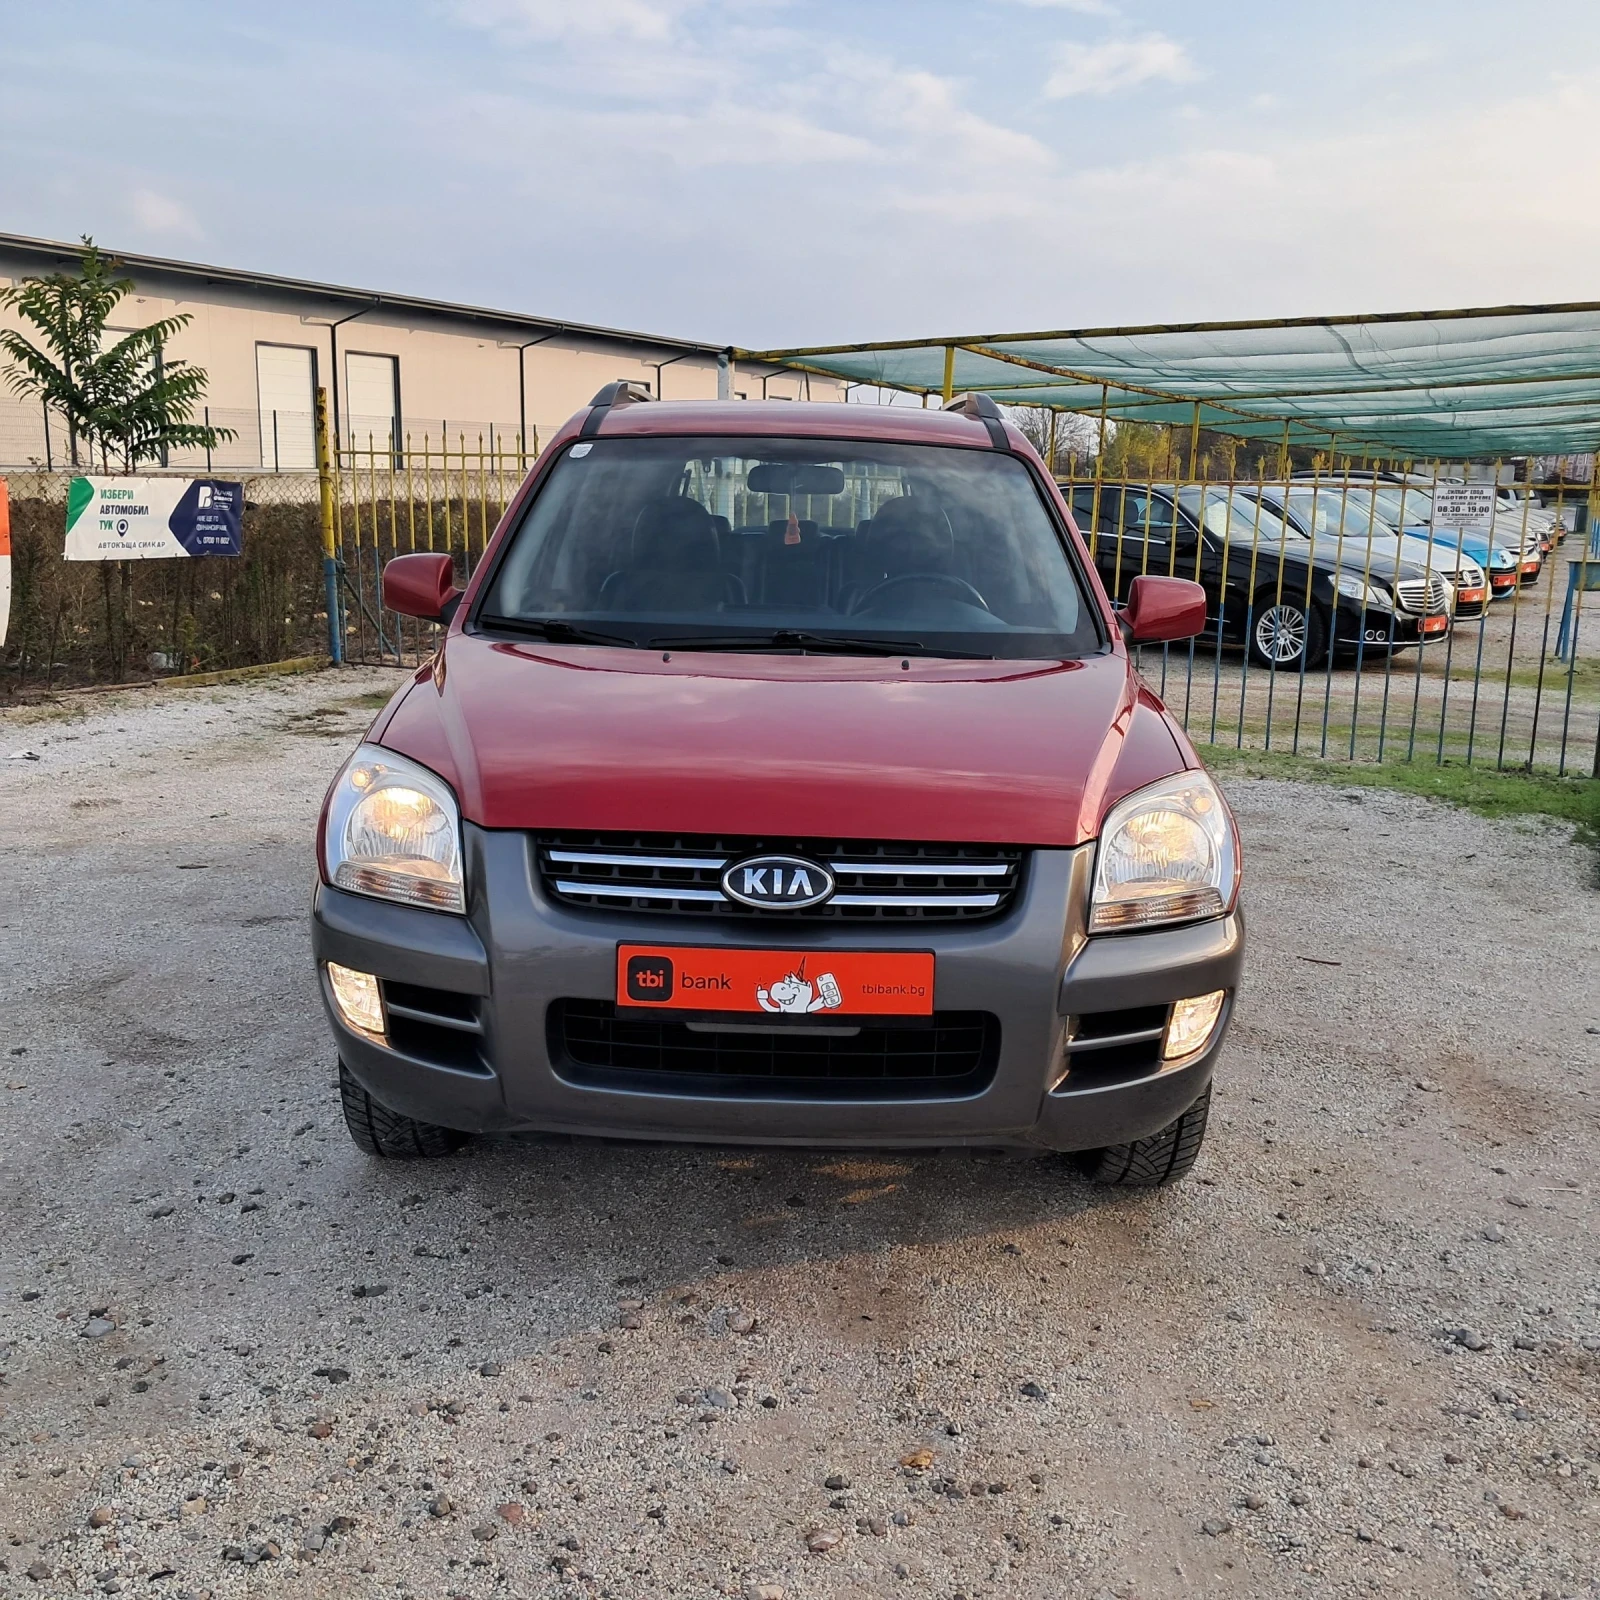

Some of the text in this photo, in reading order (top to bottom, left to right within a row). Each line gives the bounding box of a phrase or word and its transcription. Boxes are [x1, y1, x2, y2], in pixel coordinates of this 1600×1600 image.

[100, 489, 134, 500] ИЗБЕРИ
[99, 504, 149, 516] АВТОМОБИЛ
[99, 520, 114, 531] ТУК
[98, 541, 166, 550] АВТОКЪЩА СИЛКАР
[743, 867, 814, 896] KIA
[636, 969, 926, 997] tbi bank tbibank.bg
